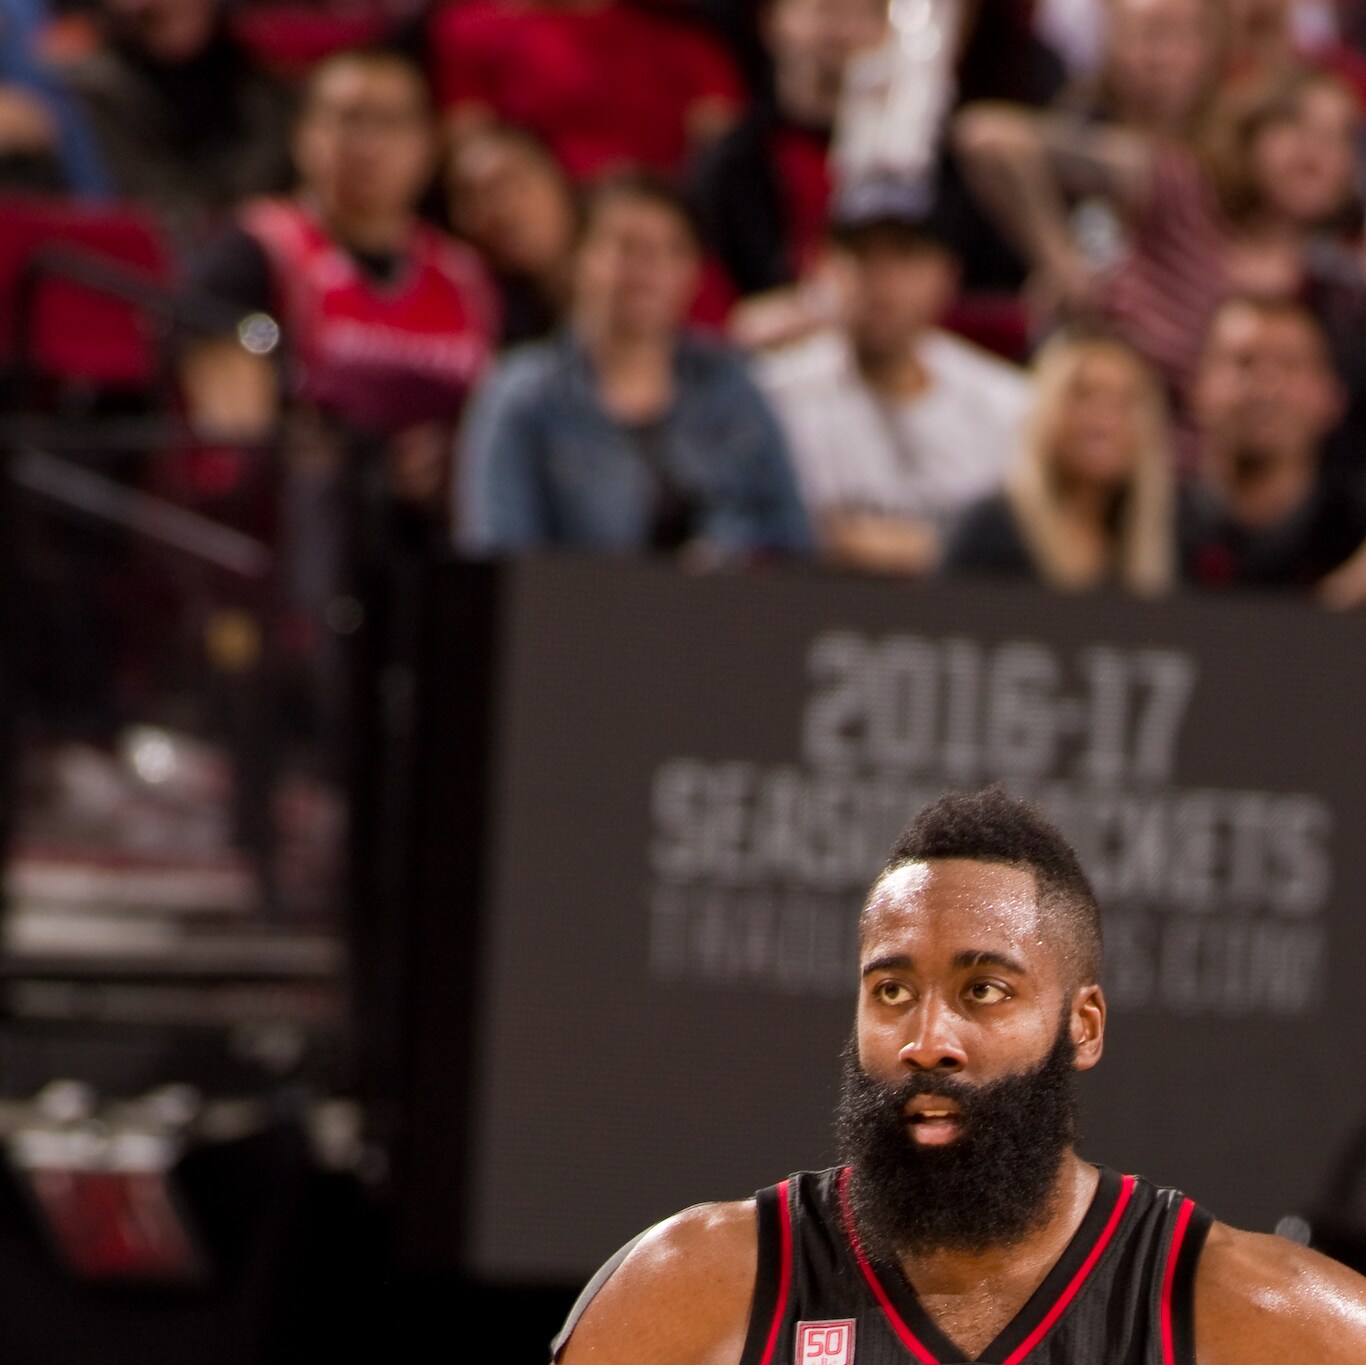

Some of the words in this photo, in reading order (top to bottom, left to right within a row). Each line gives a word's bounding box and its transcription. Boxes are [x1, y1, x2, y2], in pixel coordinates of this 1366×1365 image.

[805, 630, 1196, 782] 2016-17
[651, 757, 940, 888] SEASO
[1025, 783, 1336, 914] CKETS
[807, 1328, 843, 1357] 50
